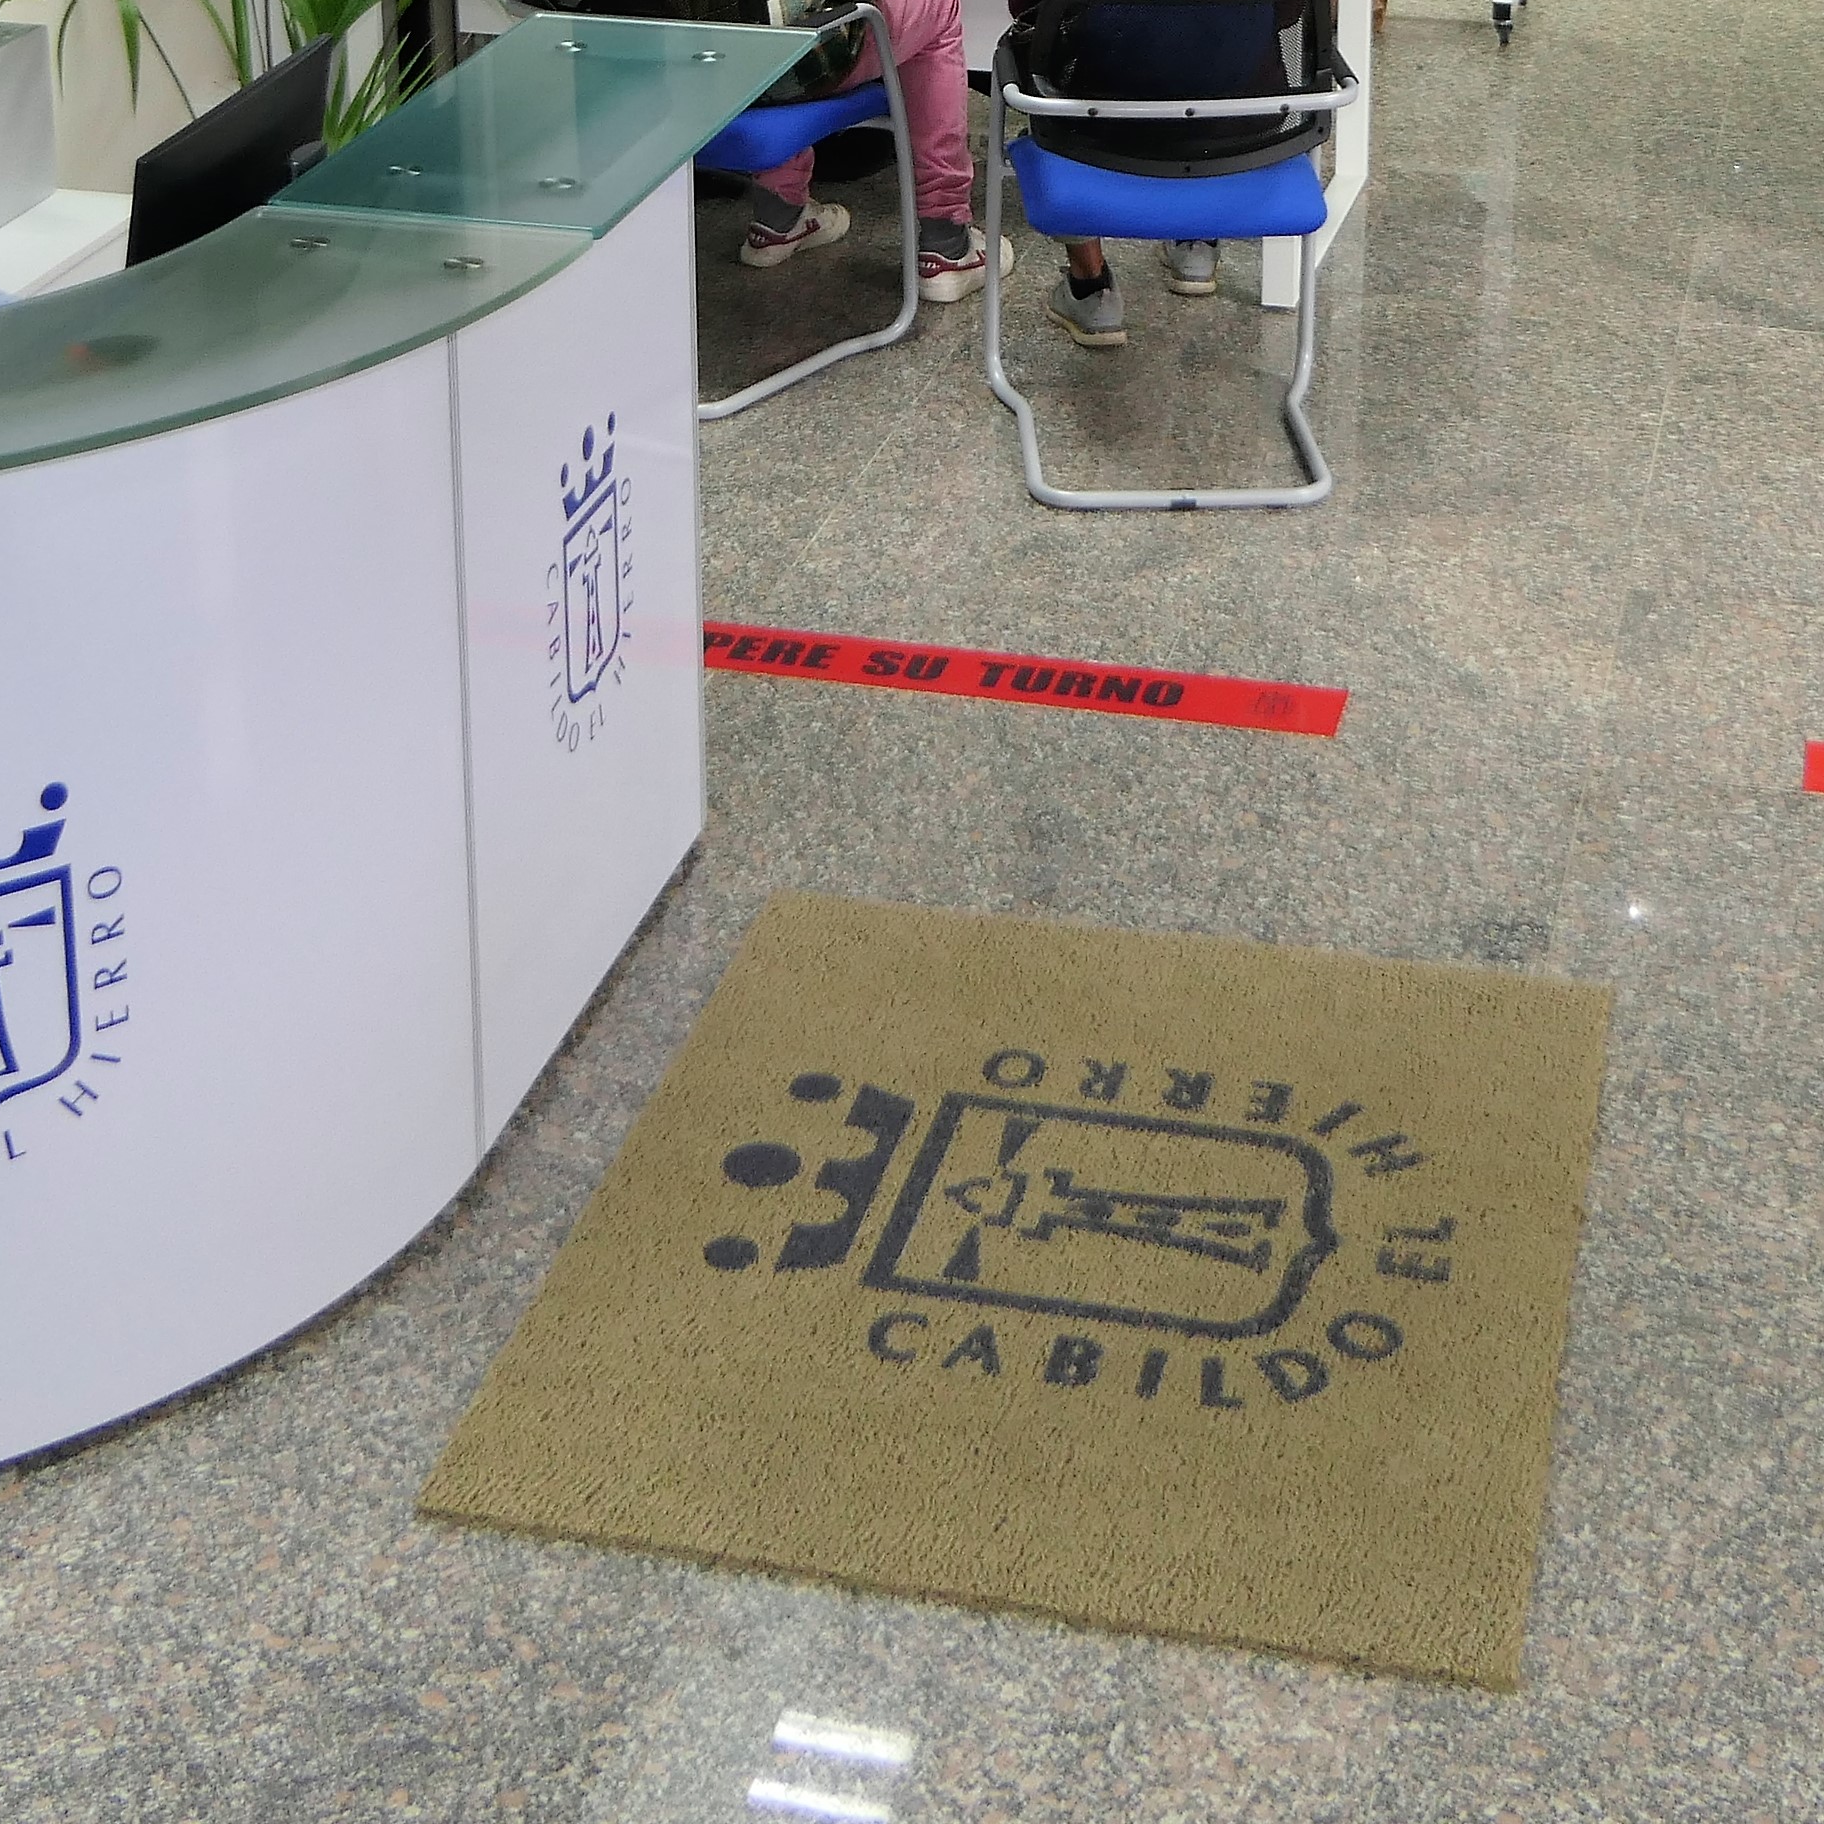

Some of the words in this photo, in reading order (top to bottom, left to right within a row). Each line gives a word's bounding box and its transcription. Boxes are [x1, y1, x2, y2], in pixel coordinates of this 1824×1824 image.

[546, 562, 580, 753] CABILDO
[589, 703, 606, 741] EL
[614, 477, 633, 685] HIERRO
[704, 631, 841, 669] PERE
[862, 650, 950, 682] SU
[979, 661, 1185, 708] TURNO
[58, 865, 130, 1117] HIERRO
[982, 1048, 1430, 1179] HIERRO
[1378, 1215, 1458, 1284] EL
[867, 1311, 1404, 1410] CABILDO
